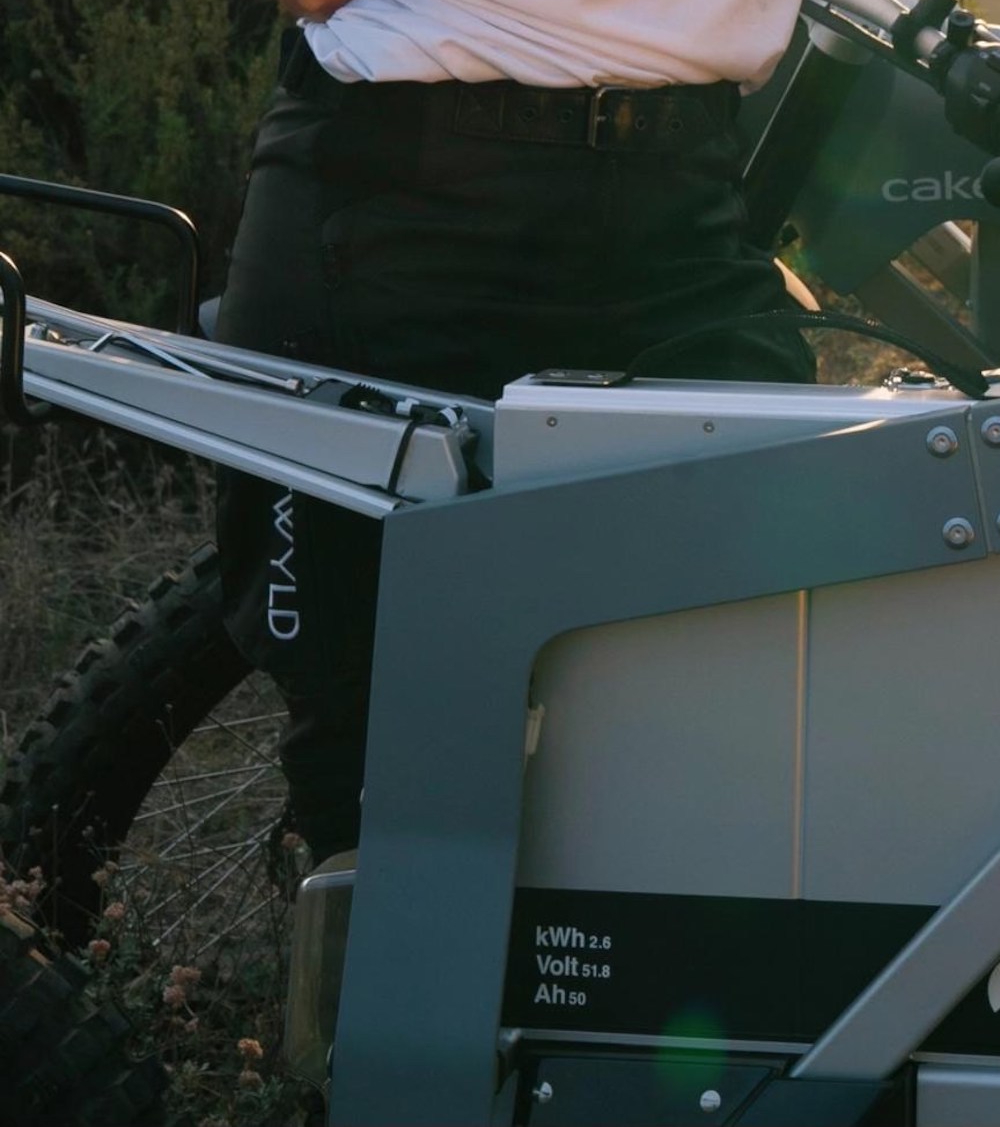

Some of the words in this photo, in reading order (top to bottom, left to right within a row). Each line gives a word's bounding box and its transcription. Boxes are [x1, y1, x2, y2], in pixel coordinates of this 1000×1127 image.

[267, 486, 300, 641] WYLD
[536, 925, 585, 948] kWh
[589, 935, 612, 950] 2.6
[536, 954, 579, 977] Volt
[582, 963, 611, 979] 51.8
[533, 982, 566, 1005] Ah
[568, 991, 587, 1006] 50
